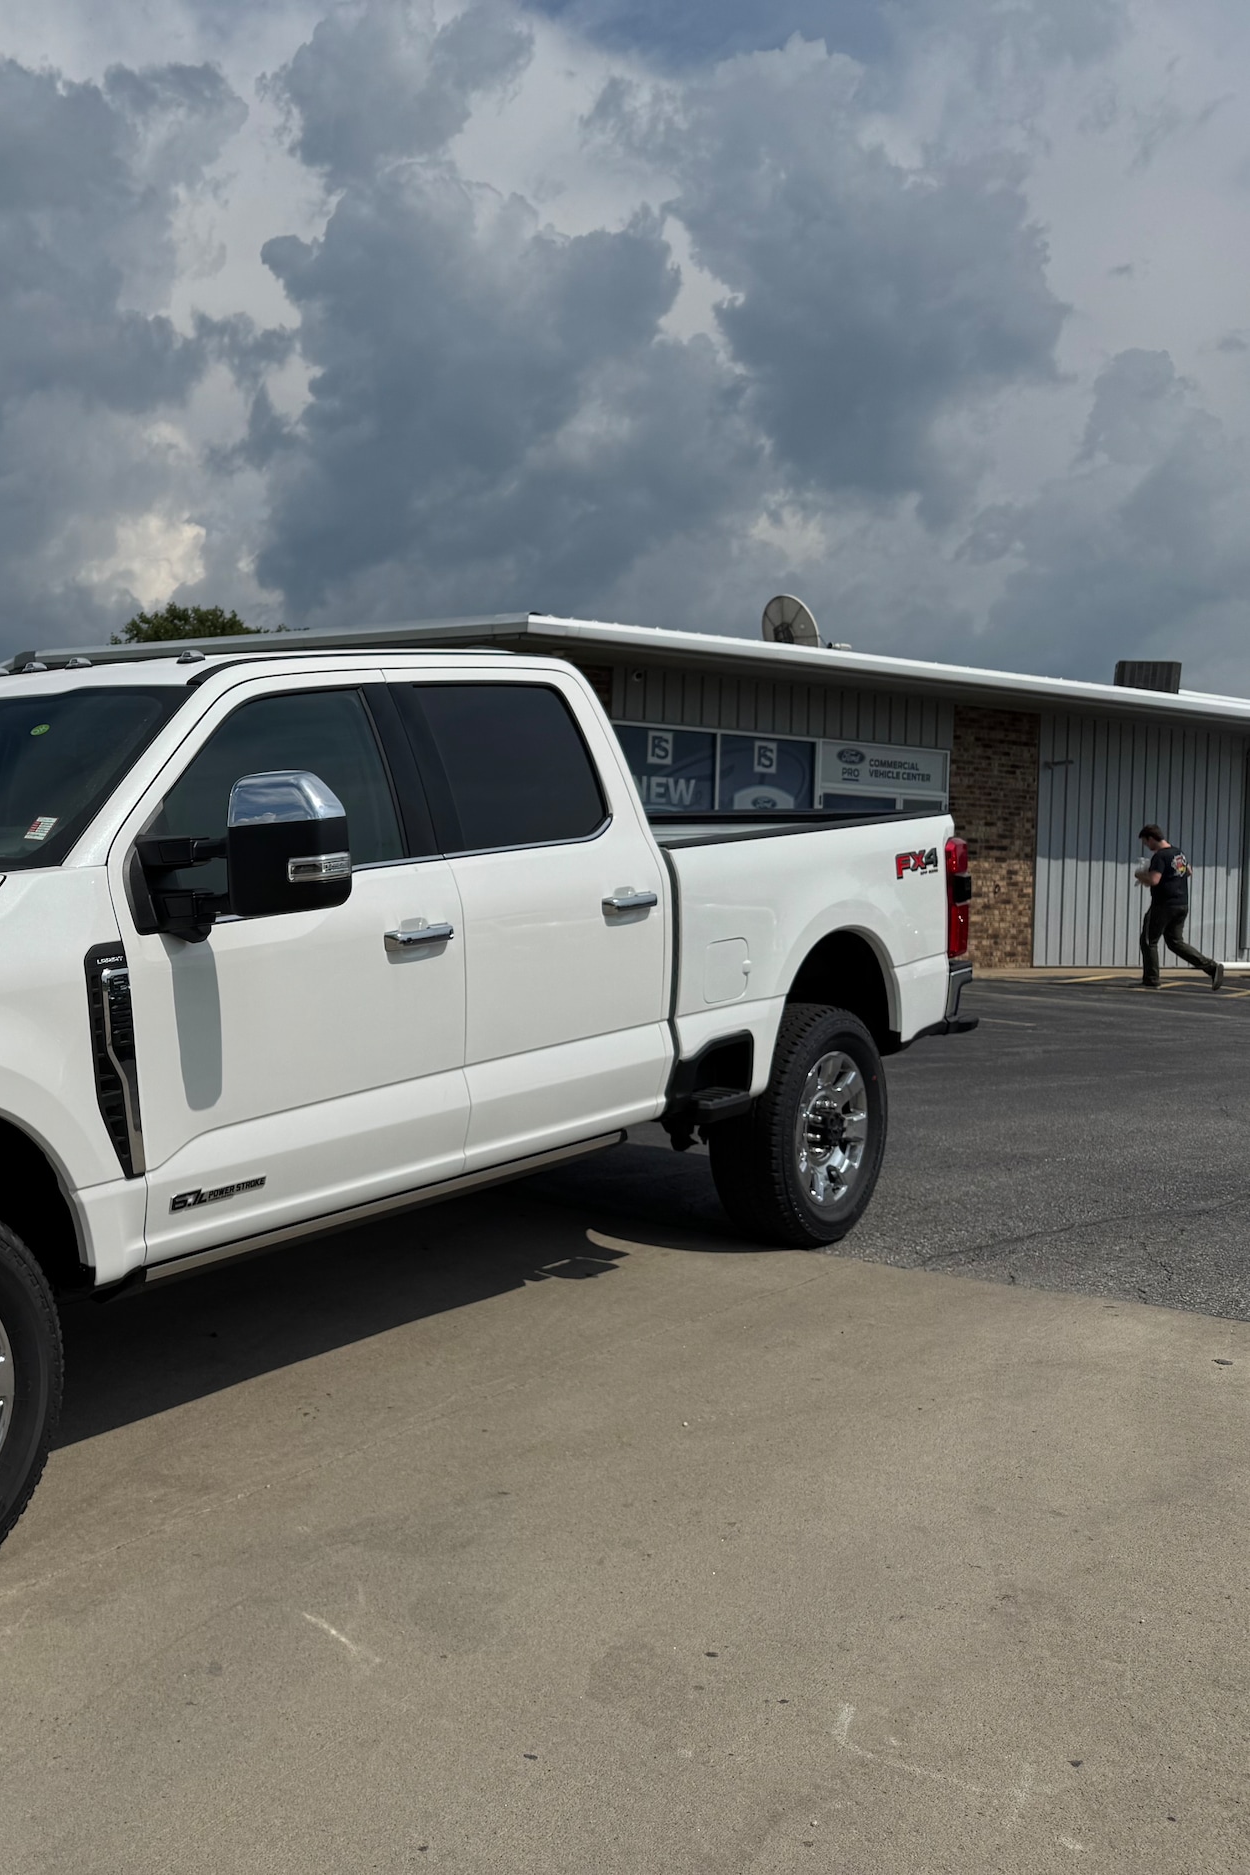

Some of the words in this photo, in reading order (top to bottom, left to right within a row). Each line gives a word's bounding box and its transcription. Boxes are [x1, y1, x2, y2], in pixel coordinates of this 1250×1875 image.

[840, 748, 863, 764] Ford
[841, 767, 860, 778] PRO
[868, 758, 920, 772] COMMERCIAL
[868, 769, 901, 781] VEHICLE
[901, 771, 931, 783] CENTER
[632, 774, 696, 805] NEW
[895, 847, 938, 880] FX4
[208, 1184, 236, 1199] POWER
[235, 1175, 267, 1192] STROKE
